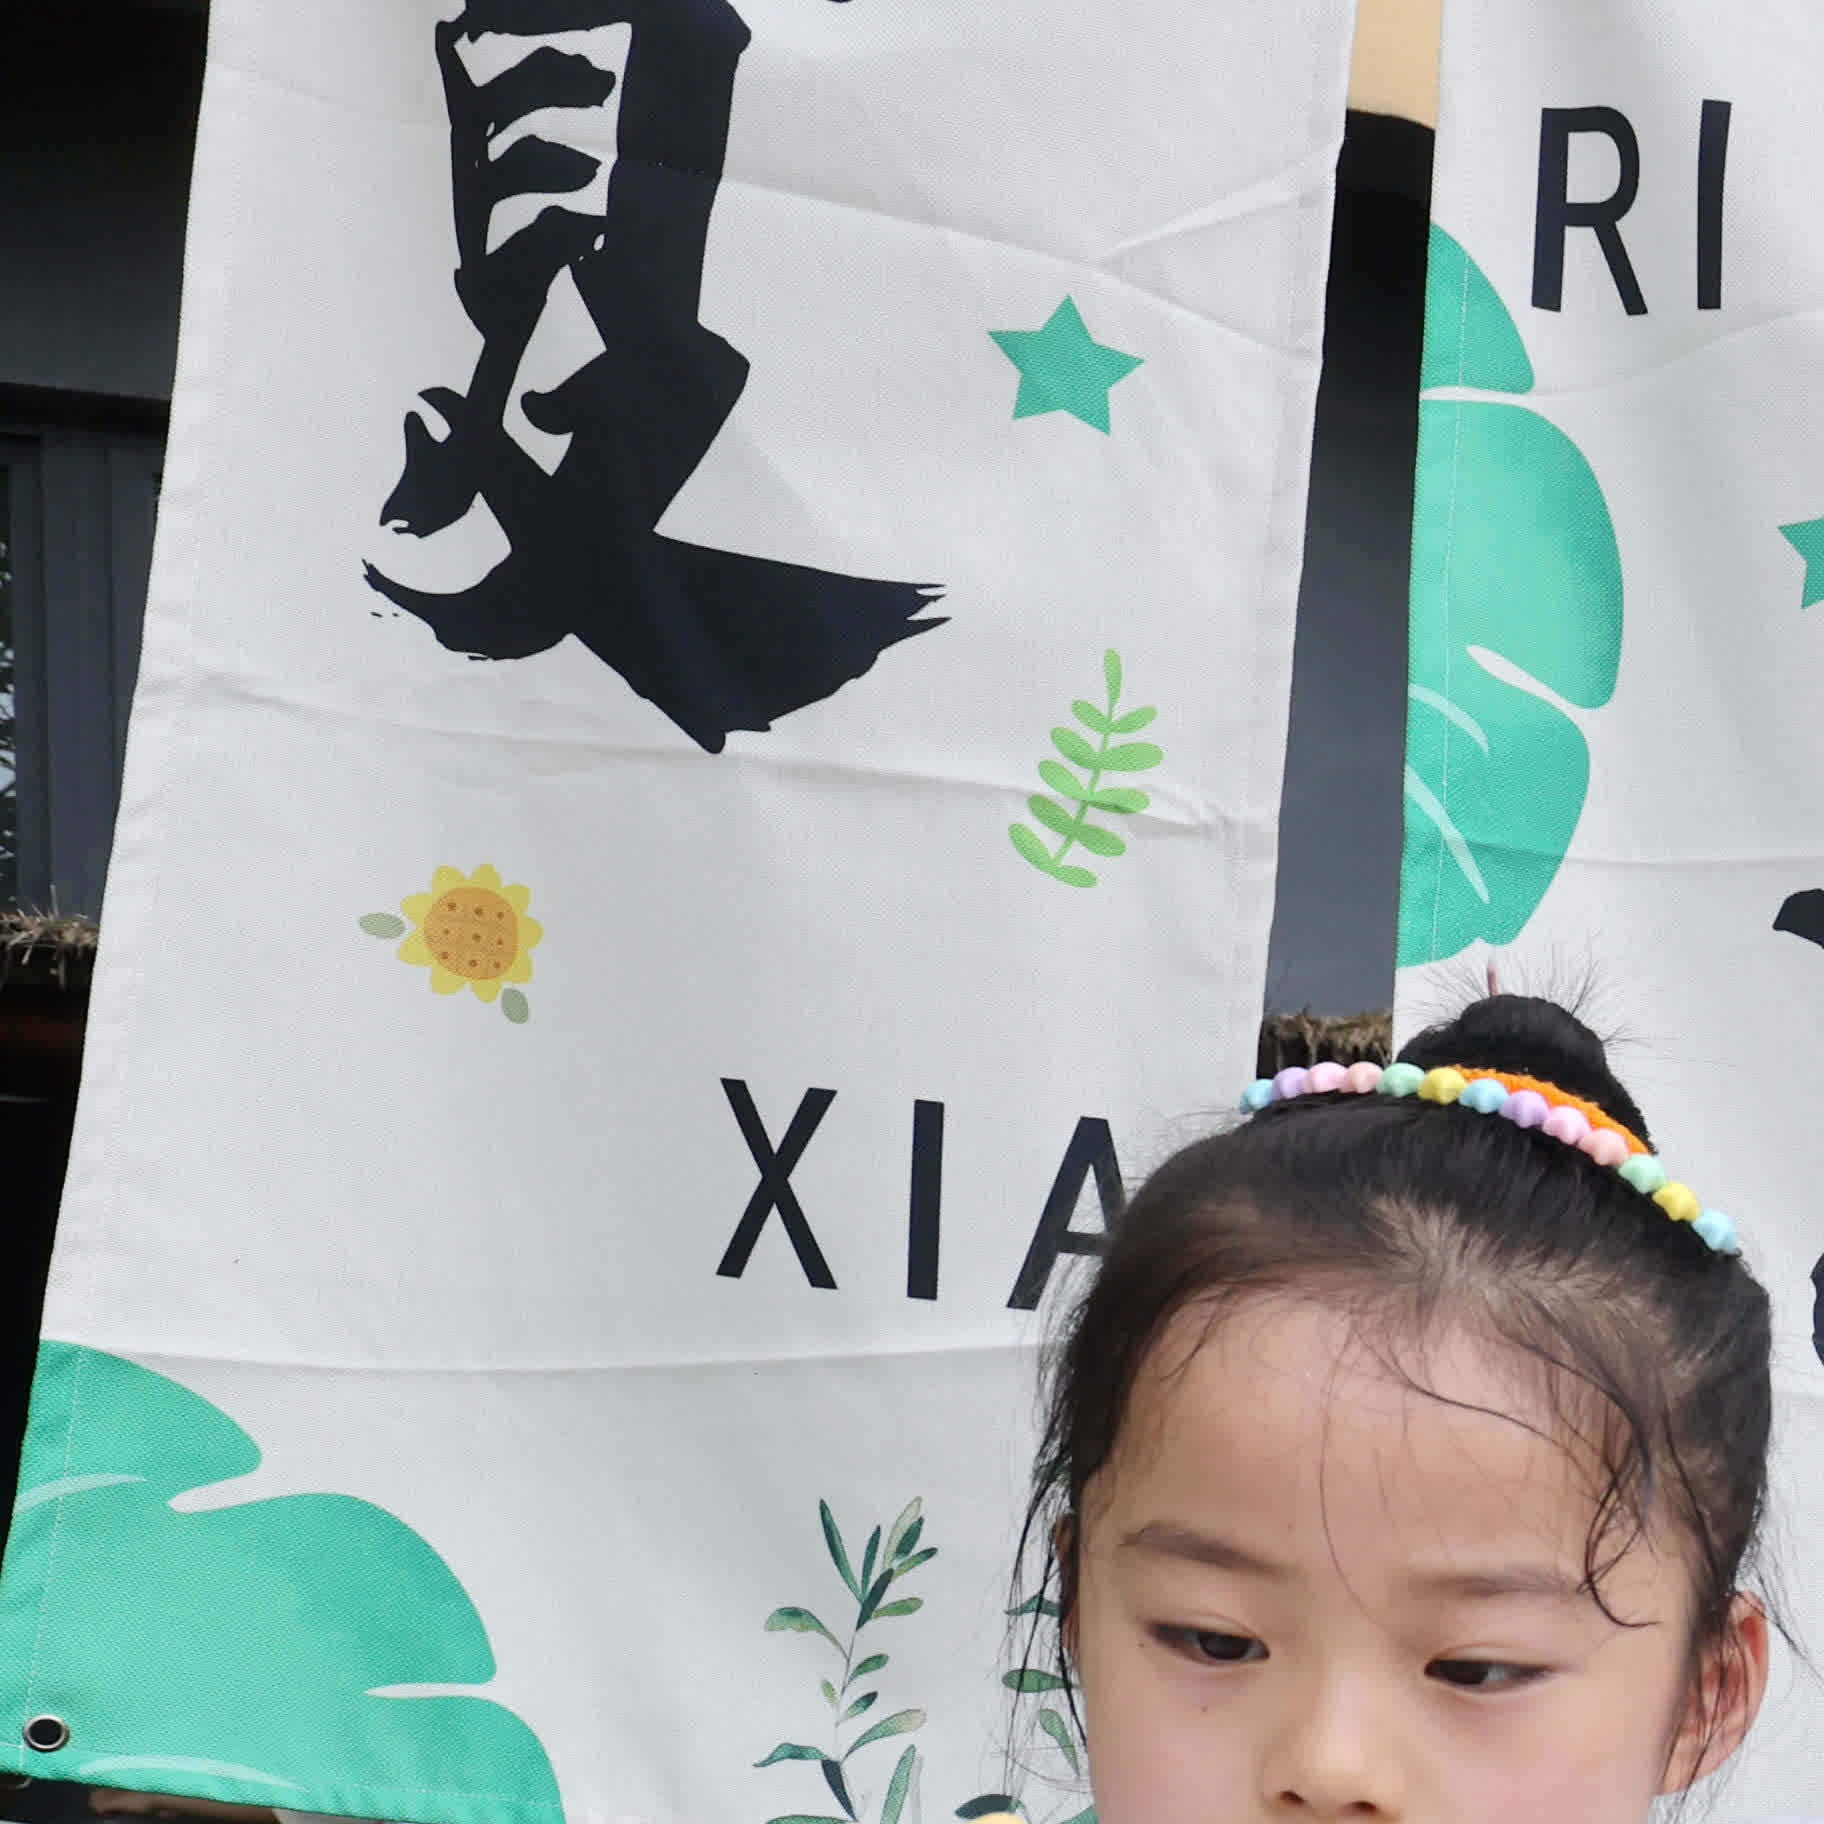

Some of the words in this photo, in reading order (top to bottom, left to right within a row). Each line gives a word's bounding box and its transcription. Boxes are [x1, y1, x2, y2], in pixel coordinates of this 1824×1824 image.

[1531, 98, 1732, 316] RI
[363, 0, 950, 755] 夏
[716, 1077, 1126, 1311] XIA
